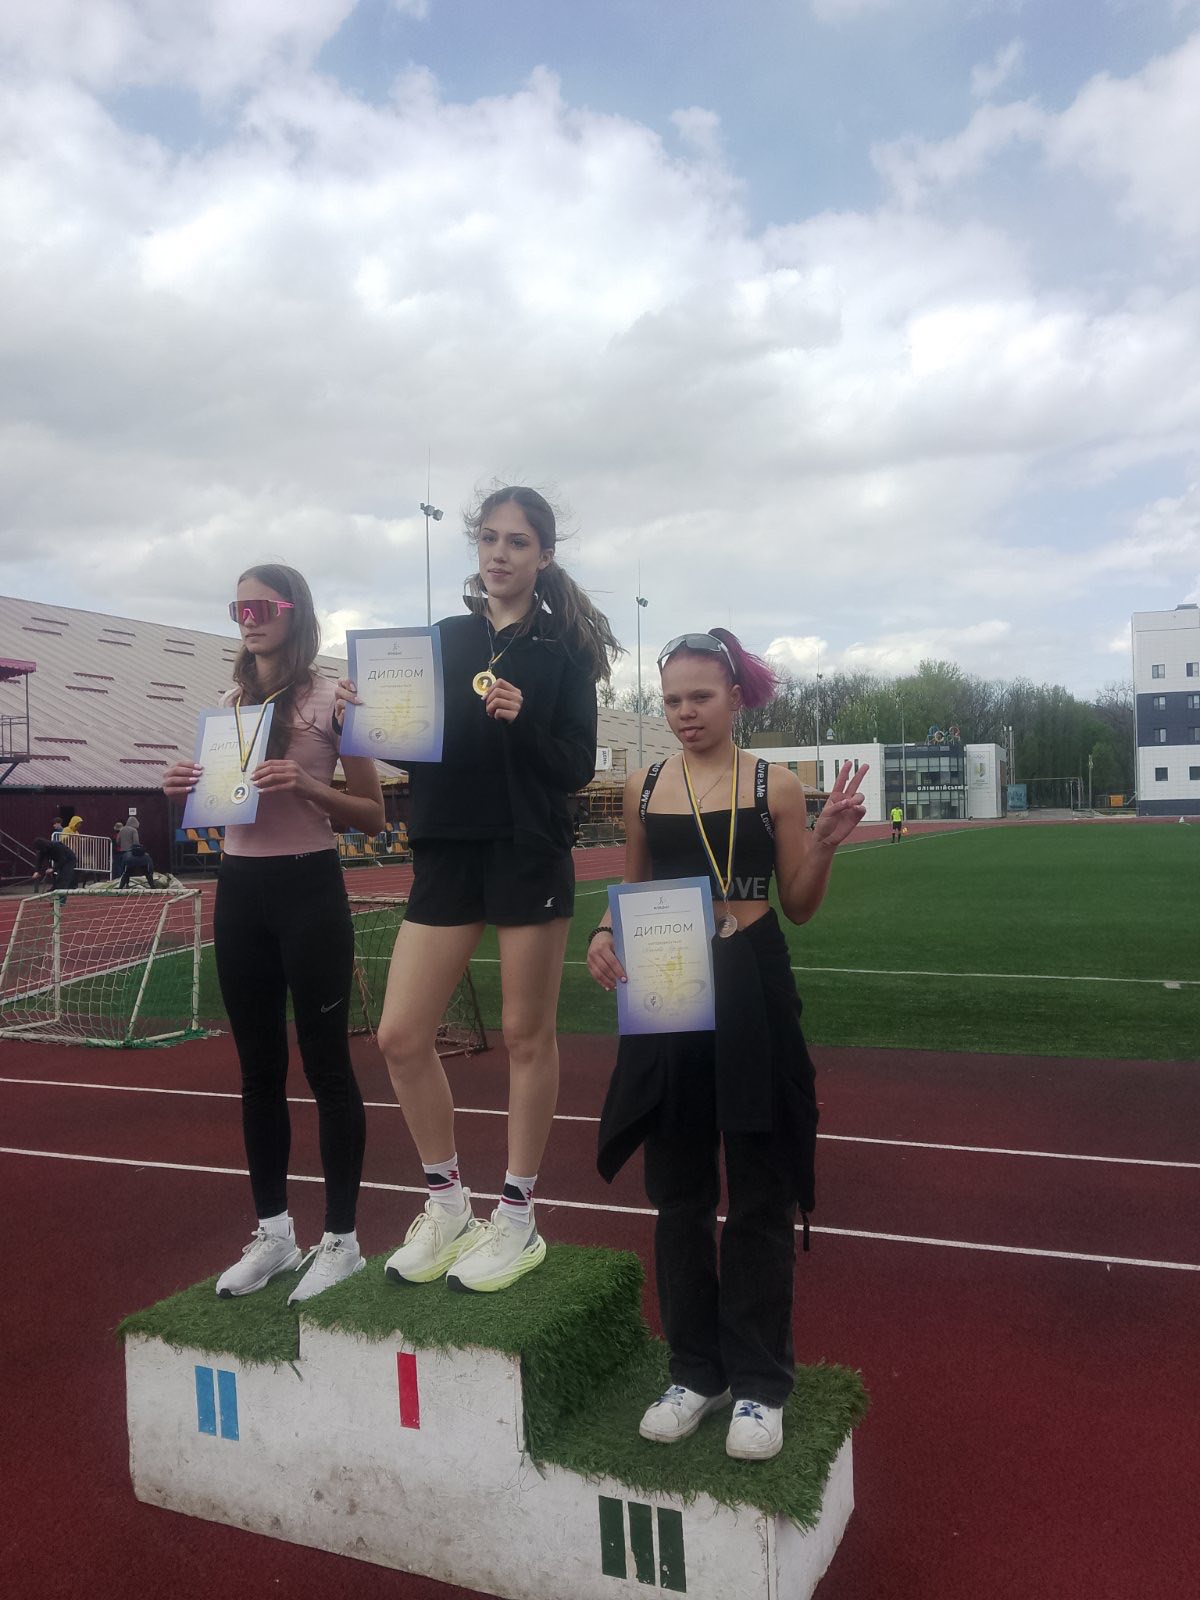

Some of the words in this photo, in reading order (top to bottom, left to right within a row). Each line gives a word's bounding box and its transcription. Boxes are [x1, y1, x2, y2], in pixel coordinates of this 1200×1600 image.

[368, 668, 423, 680] ДИПЛОМ
[482, 679, 489, 689] 1
[209, 741, 251, 752] ДИПЛМ
[236, 789, 244, 798] 2
[634, 922, 693, 938] ДИПЛОМ
